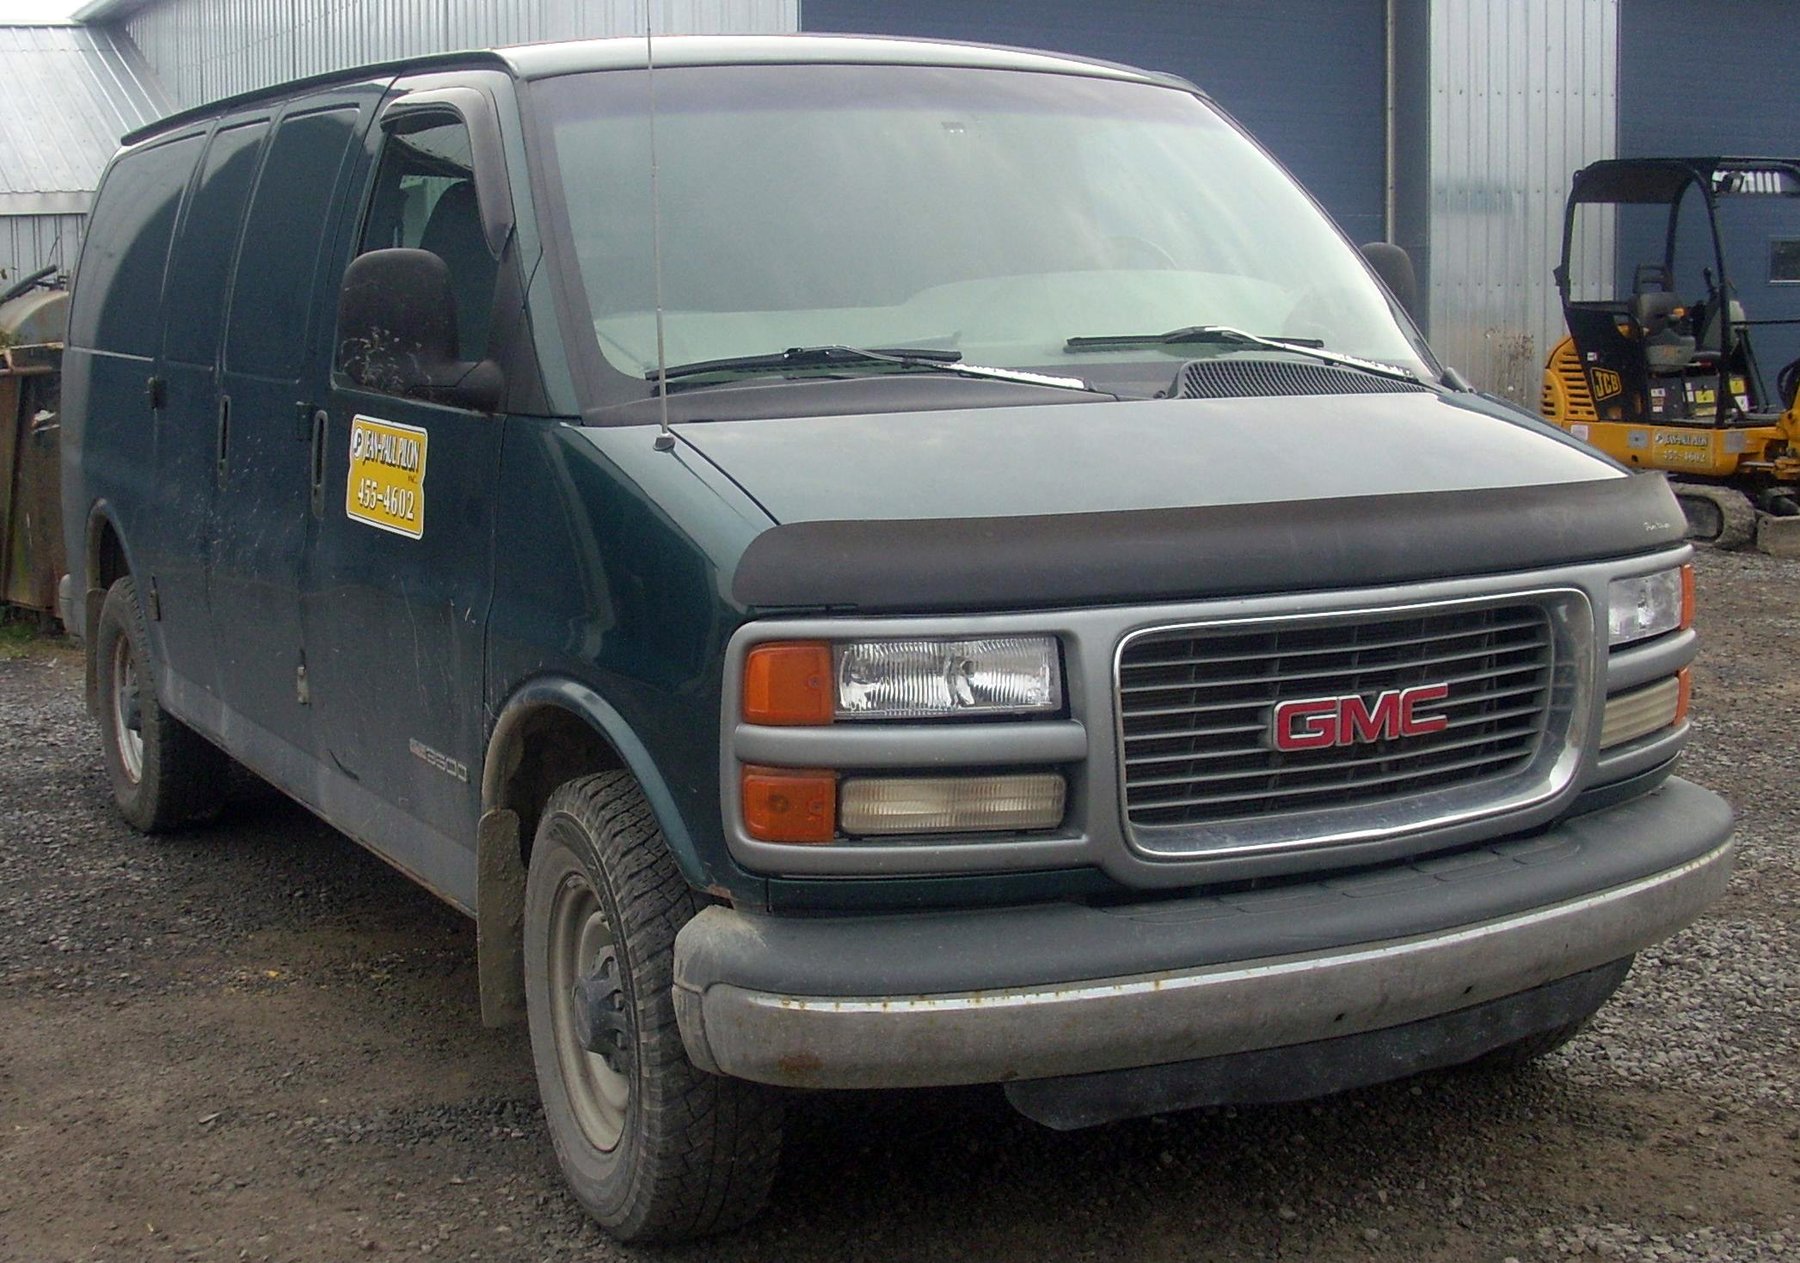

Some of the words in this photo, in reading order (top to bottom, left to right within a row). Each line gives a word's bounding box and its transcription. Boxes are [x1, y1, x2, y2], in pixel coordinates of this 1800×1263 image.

[1595, 371, 1619, 397] JCB
[358, 478, 414, 520] 455-4602
[1274, 683, 1448, 752] GMC
